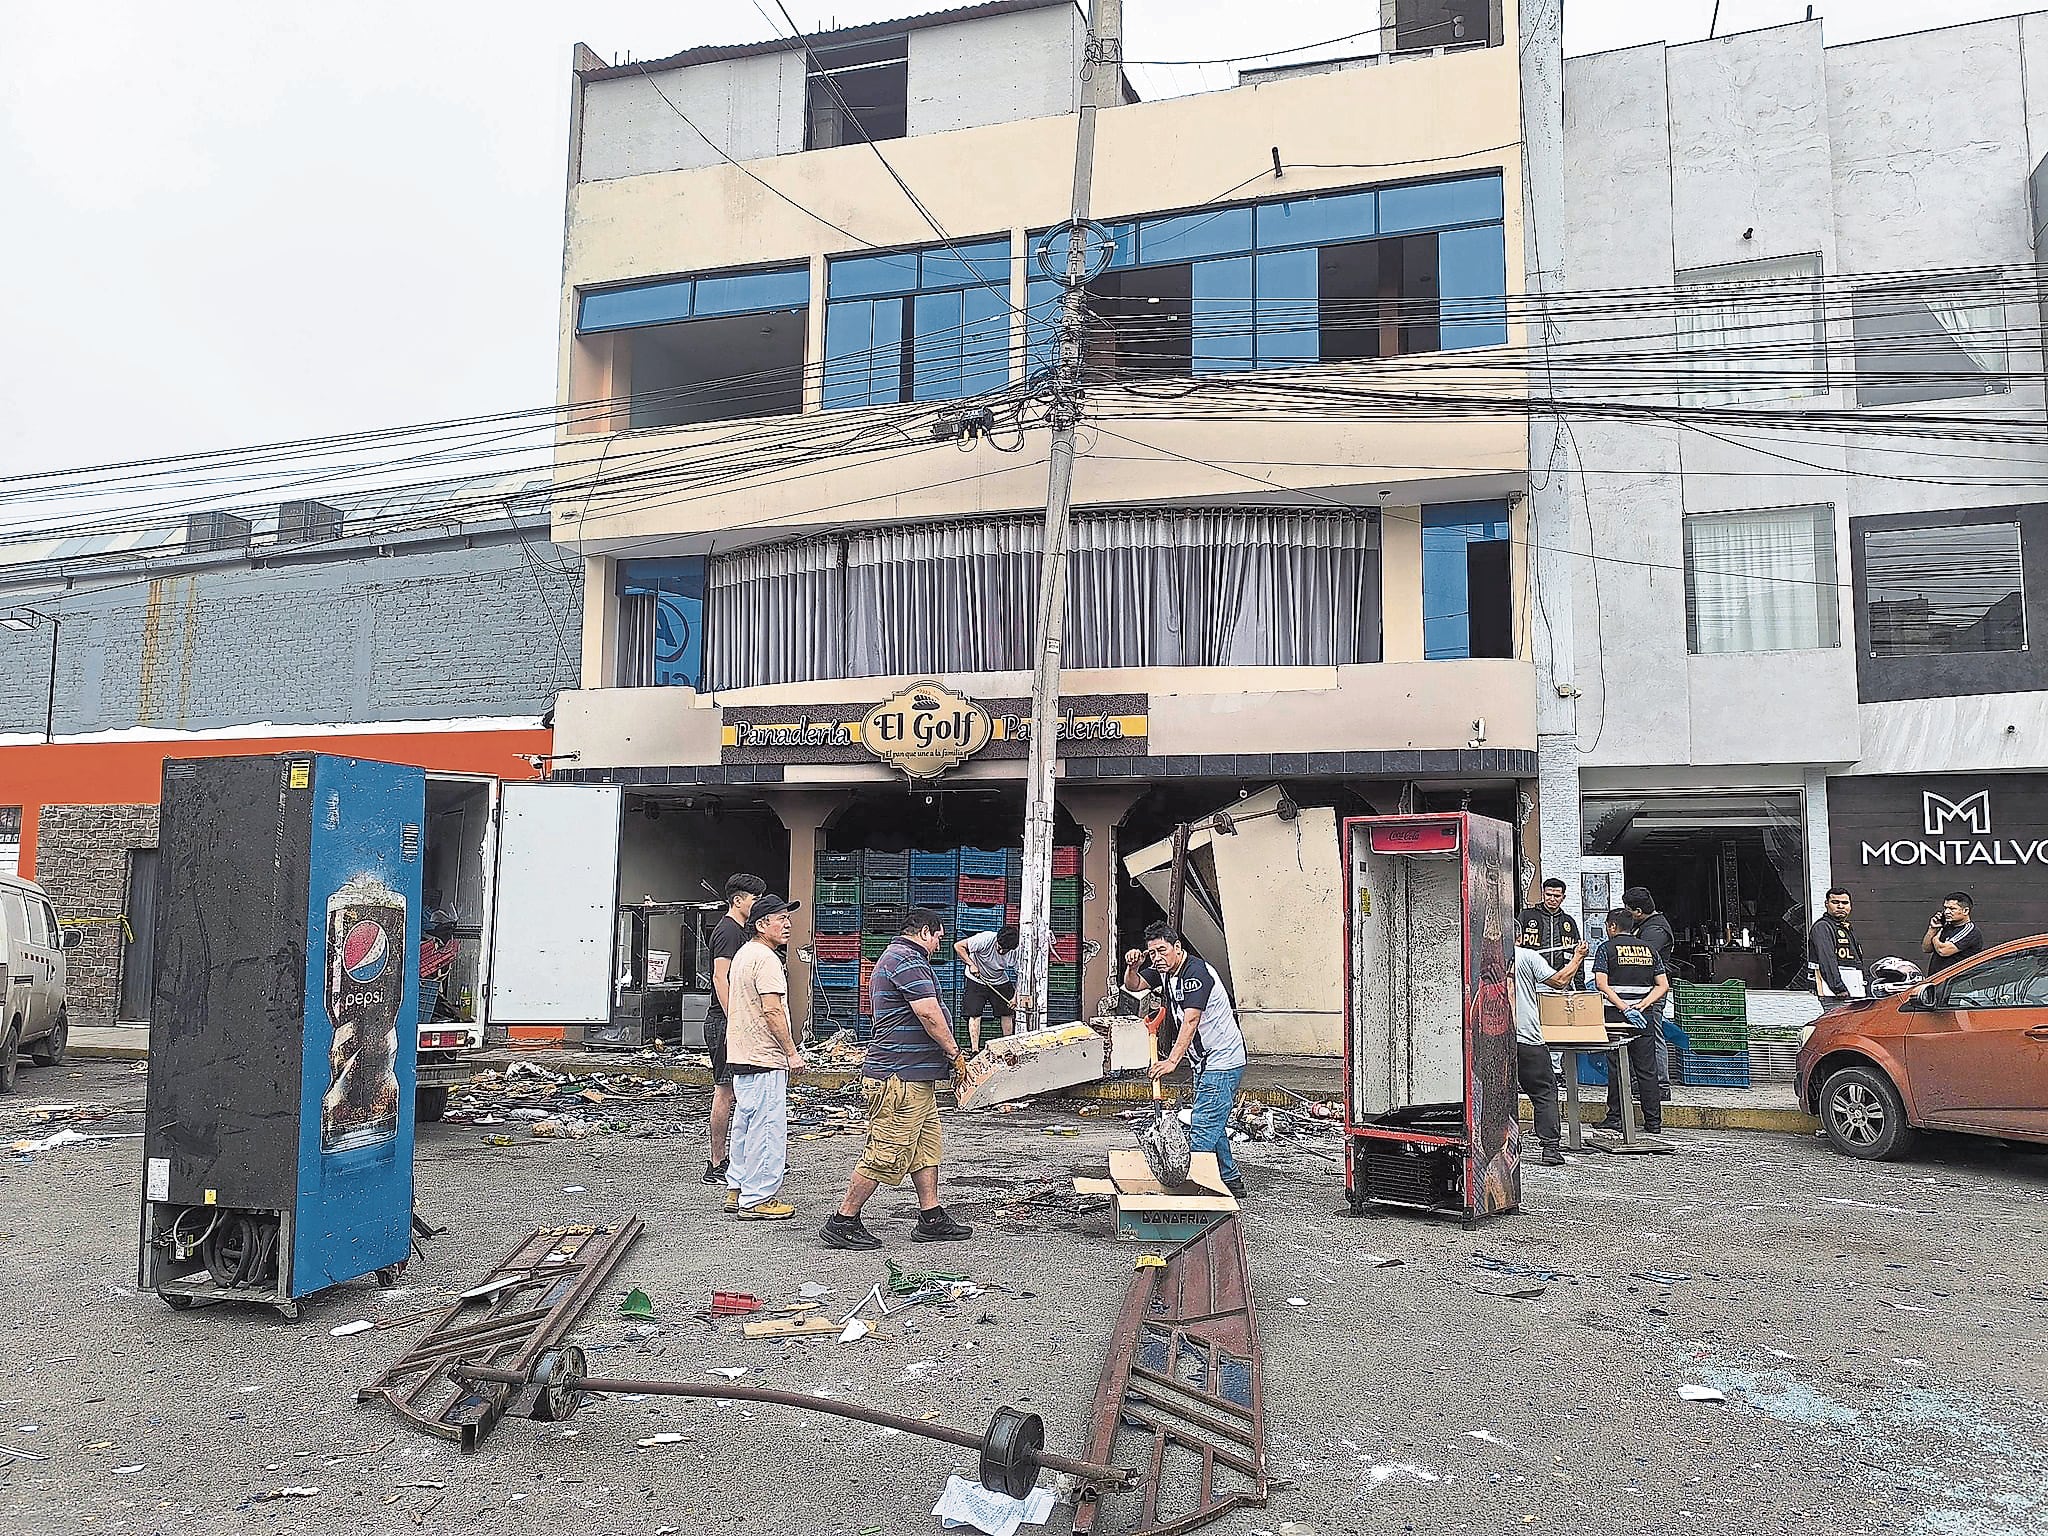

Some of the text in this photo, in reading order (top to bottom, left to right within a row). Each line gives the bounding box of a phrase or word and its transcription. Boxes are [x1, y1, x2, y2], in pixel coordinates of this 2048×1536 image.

[734, 714, 851, 747] Panadería
[873, 711, 978, 749] El Golf
[1000, 707, 1122, 741] Paelería
[905, 751, 917, 760] que
[935, 748, 942, 758] la
[941, 748, 964, 759] familia
[1523, 933, 1541, 947] POL
[345, 987, 384, 1010] pepsi
